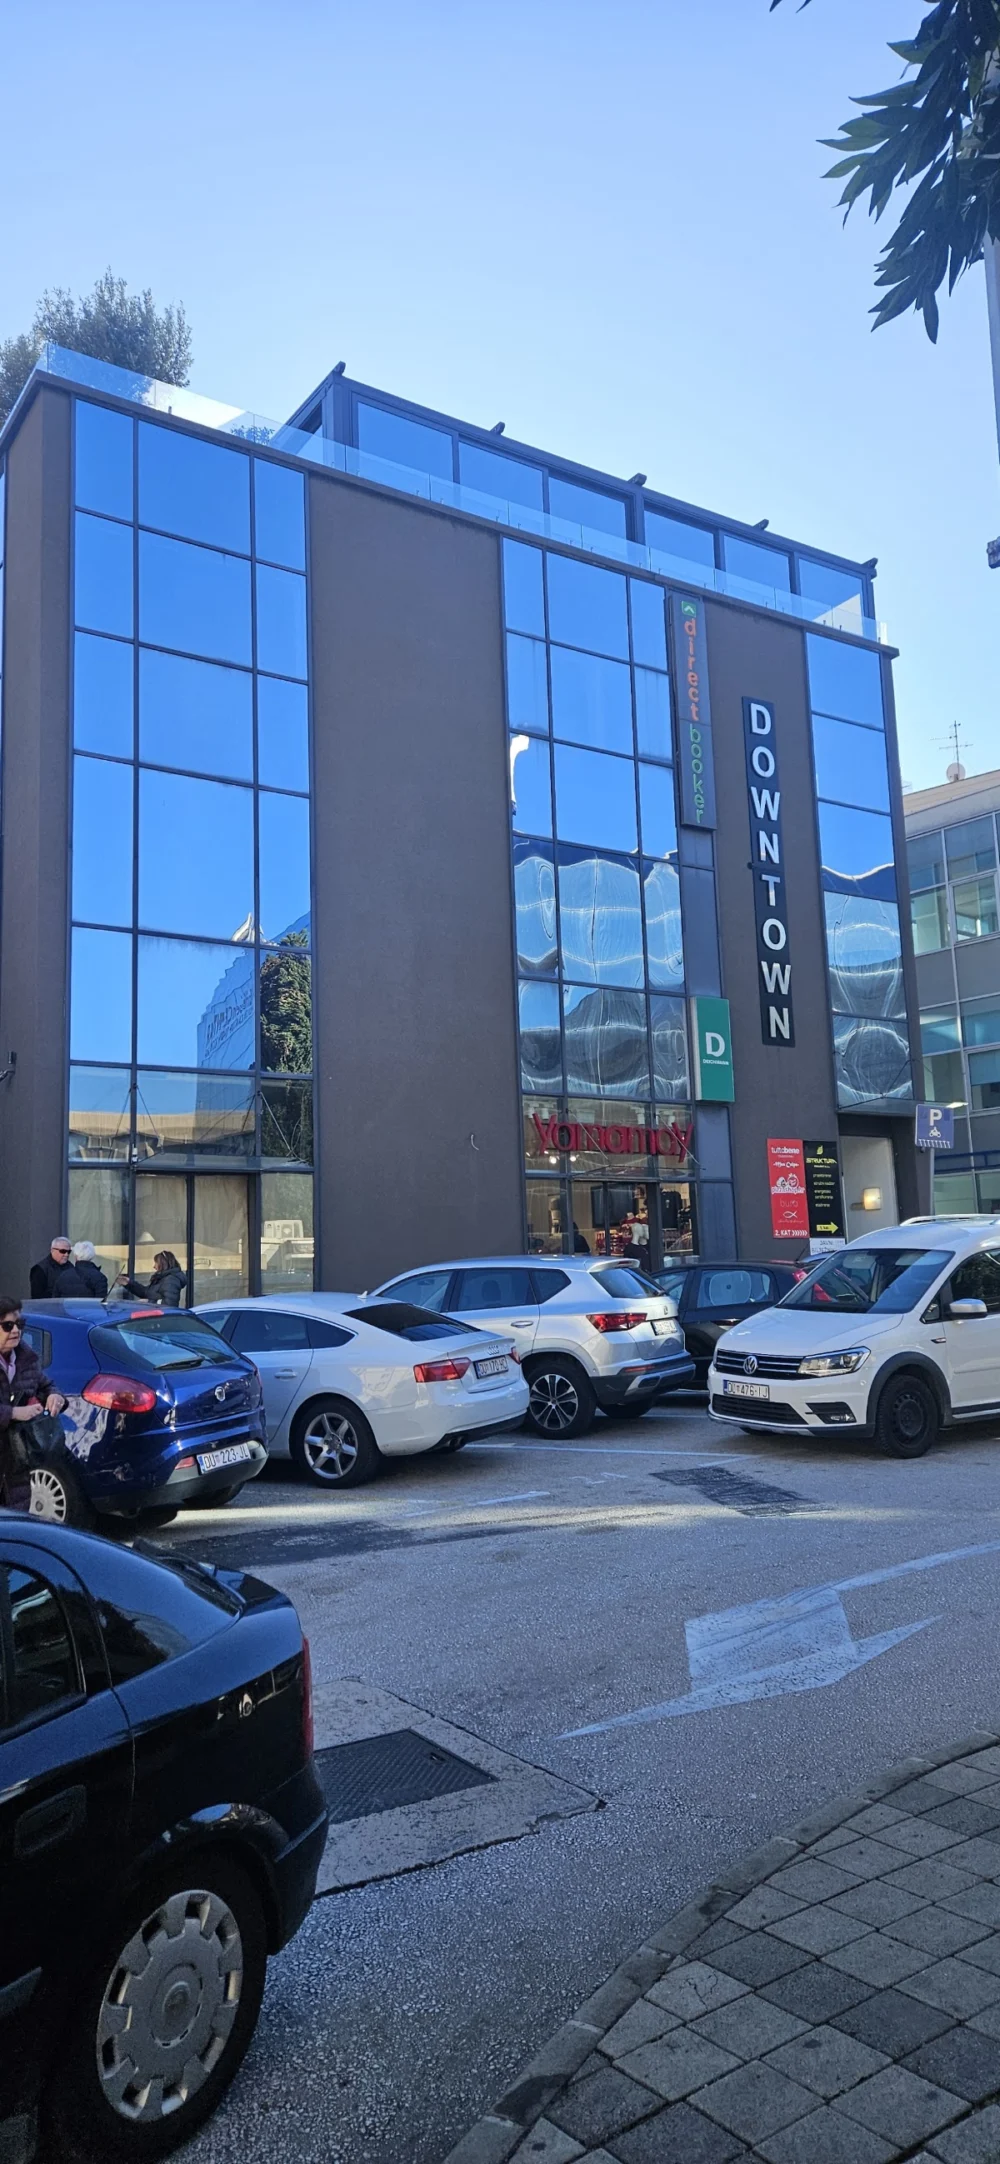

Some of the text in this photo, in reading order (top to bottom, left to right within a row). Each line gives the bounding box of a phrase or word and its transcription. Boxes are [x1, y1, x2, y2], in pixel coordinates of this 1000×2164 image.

[684, 618, 704, 823] direct booker
[750, 702, 791, 1041] DOWNTOWN
[705, 1031, 725, 1057] D
[930, 1109, 942, 1126] P
